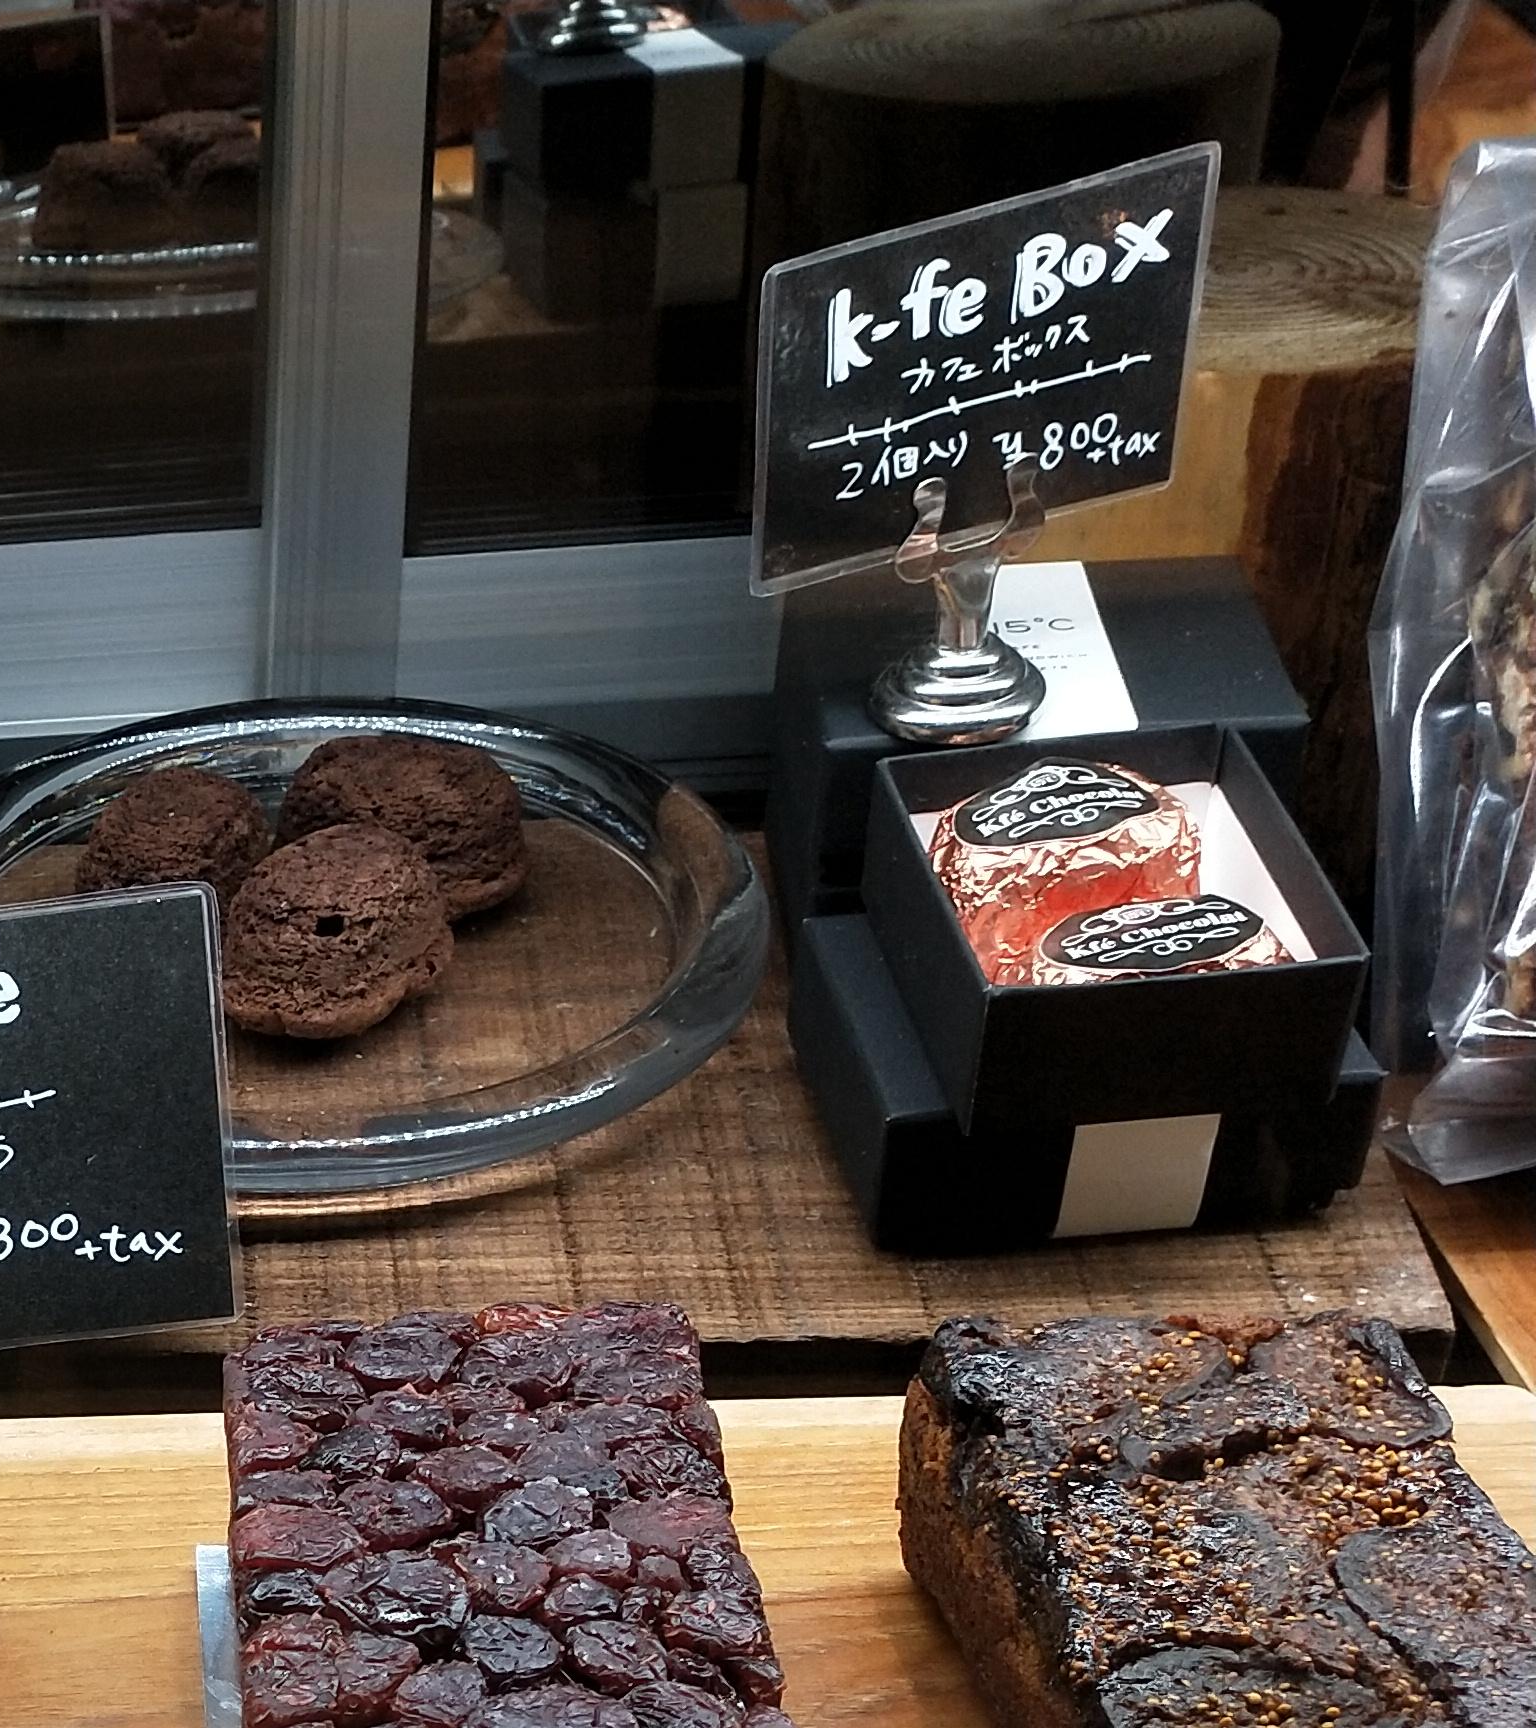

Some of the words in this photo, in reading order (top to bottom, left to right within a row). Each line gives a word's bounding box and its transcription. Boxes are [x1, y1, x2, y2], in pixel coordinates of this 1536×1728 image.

[826, 257, 987, 388] k-fe
[835, 430, 969, 500] 2個入り
[1120, 910, 1249, 943] Chocolat
